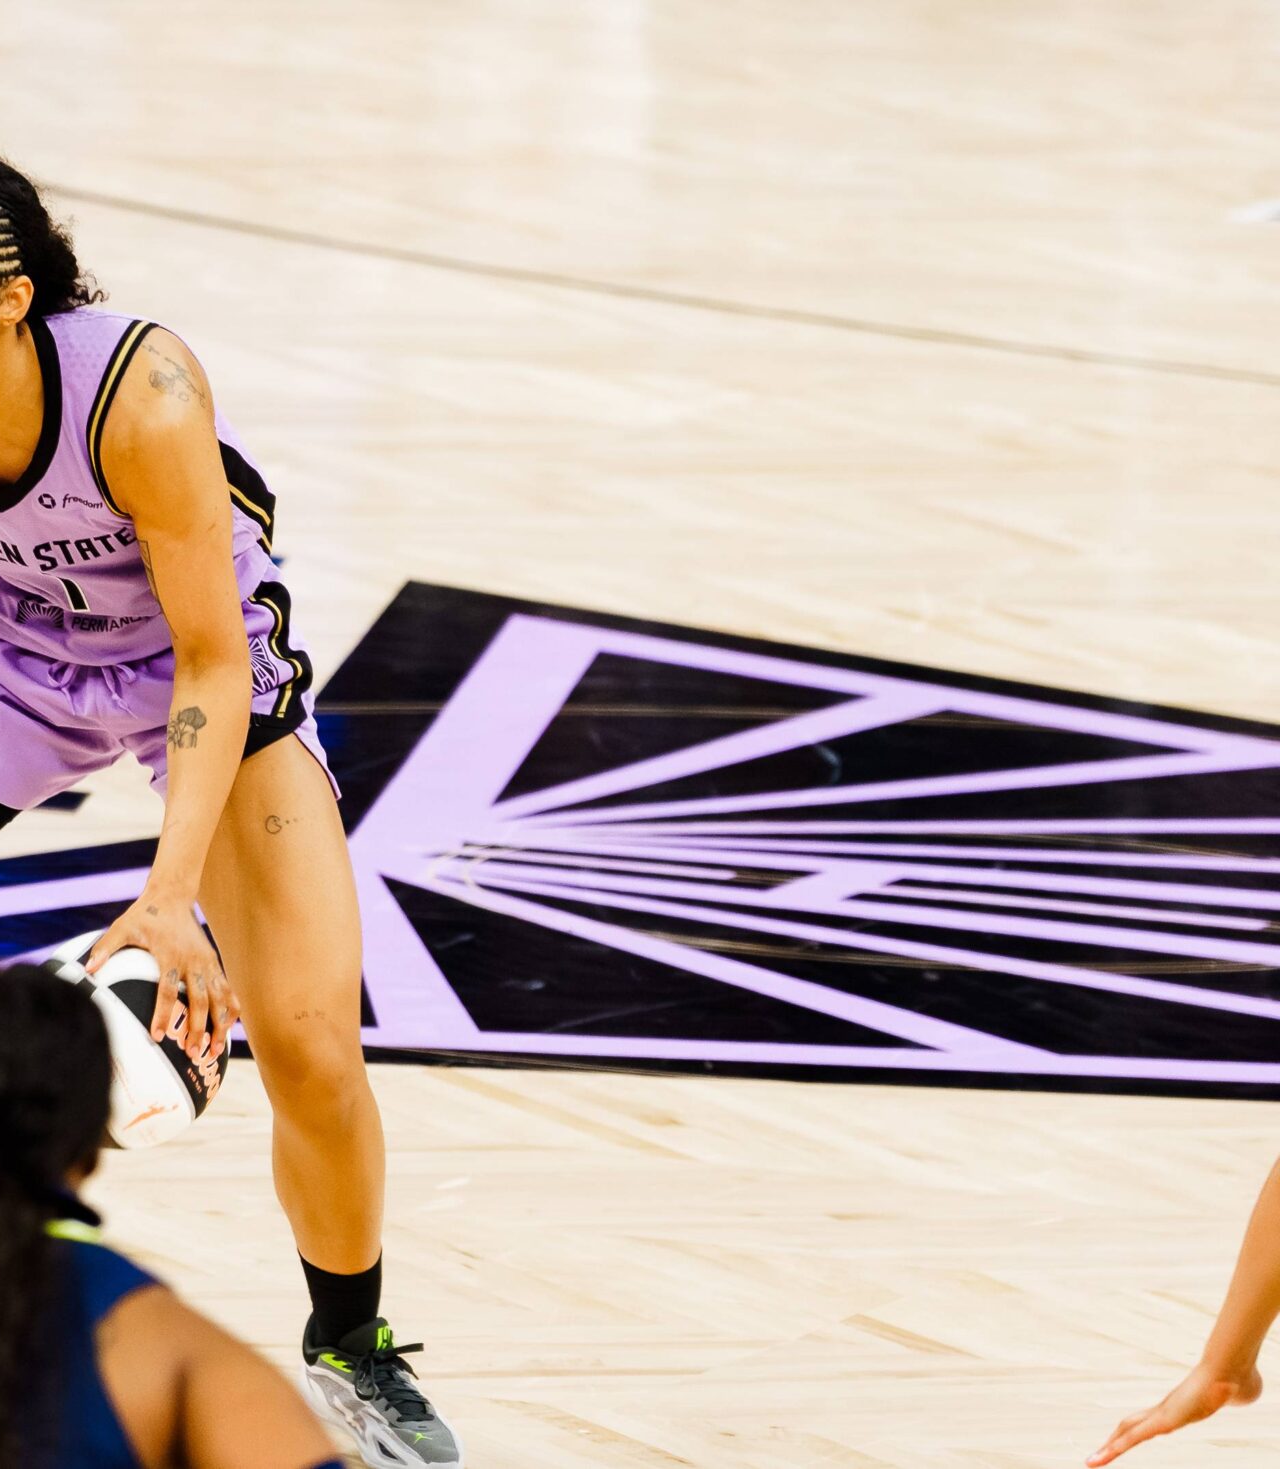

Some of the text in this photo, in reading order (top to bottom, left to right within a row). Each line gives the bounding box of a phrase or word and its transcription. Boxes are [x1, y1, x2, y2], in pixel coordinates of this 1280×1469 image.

[62, 493, 103, 509] freedom
[33, 526, 138, 572] STATE
[56, 576, 91, 612] 1
